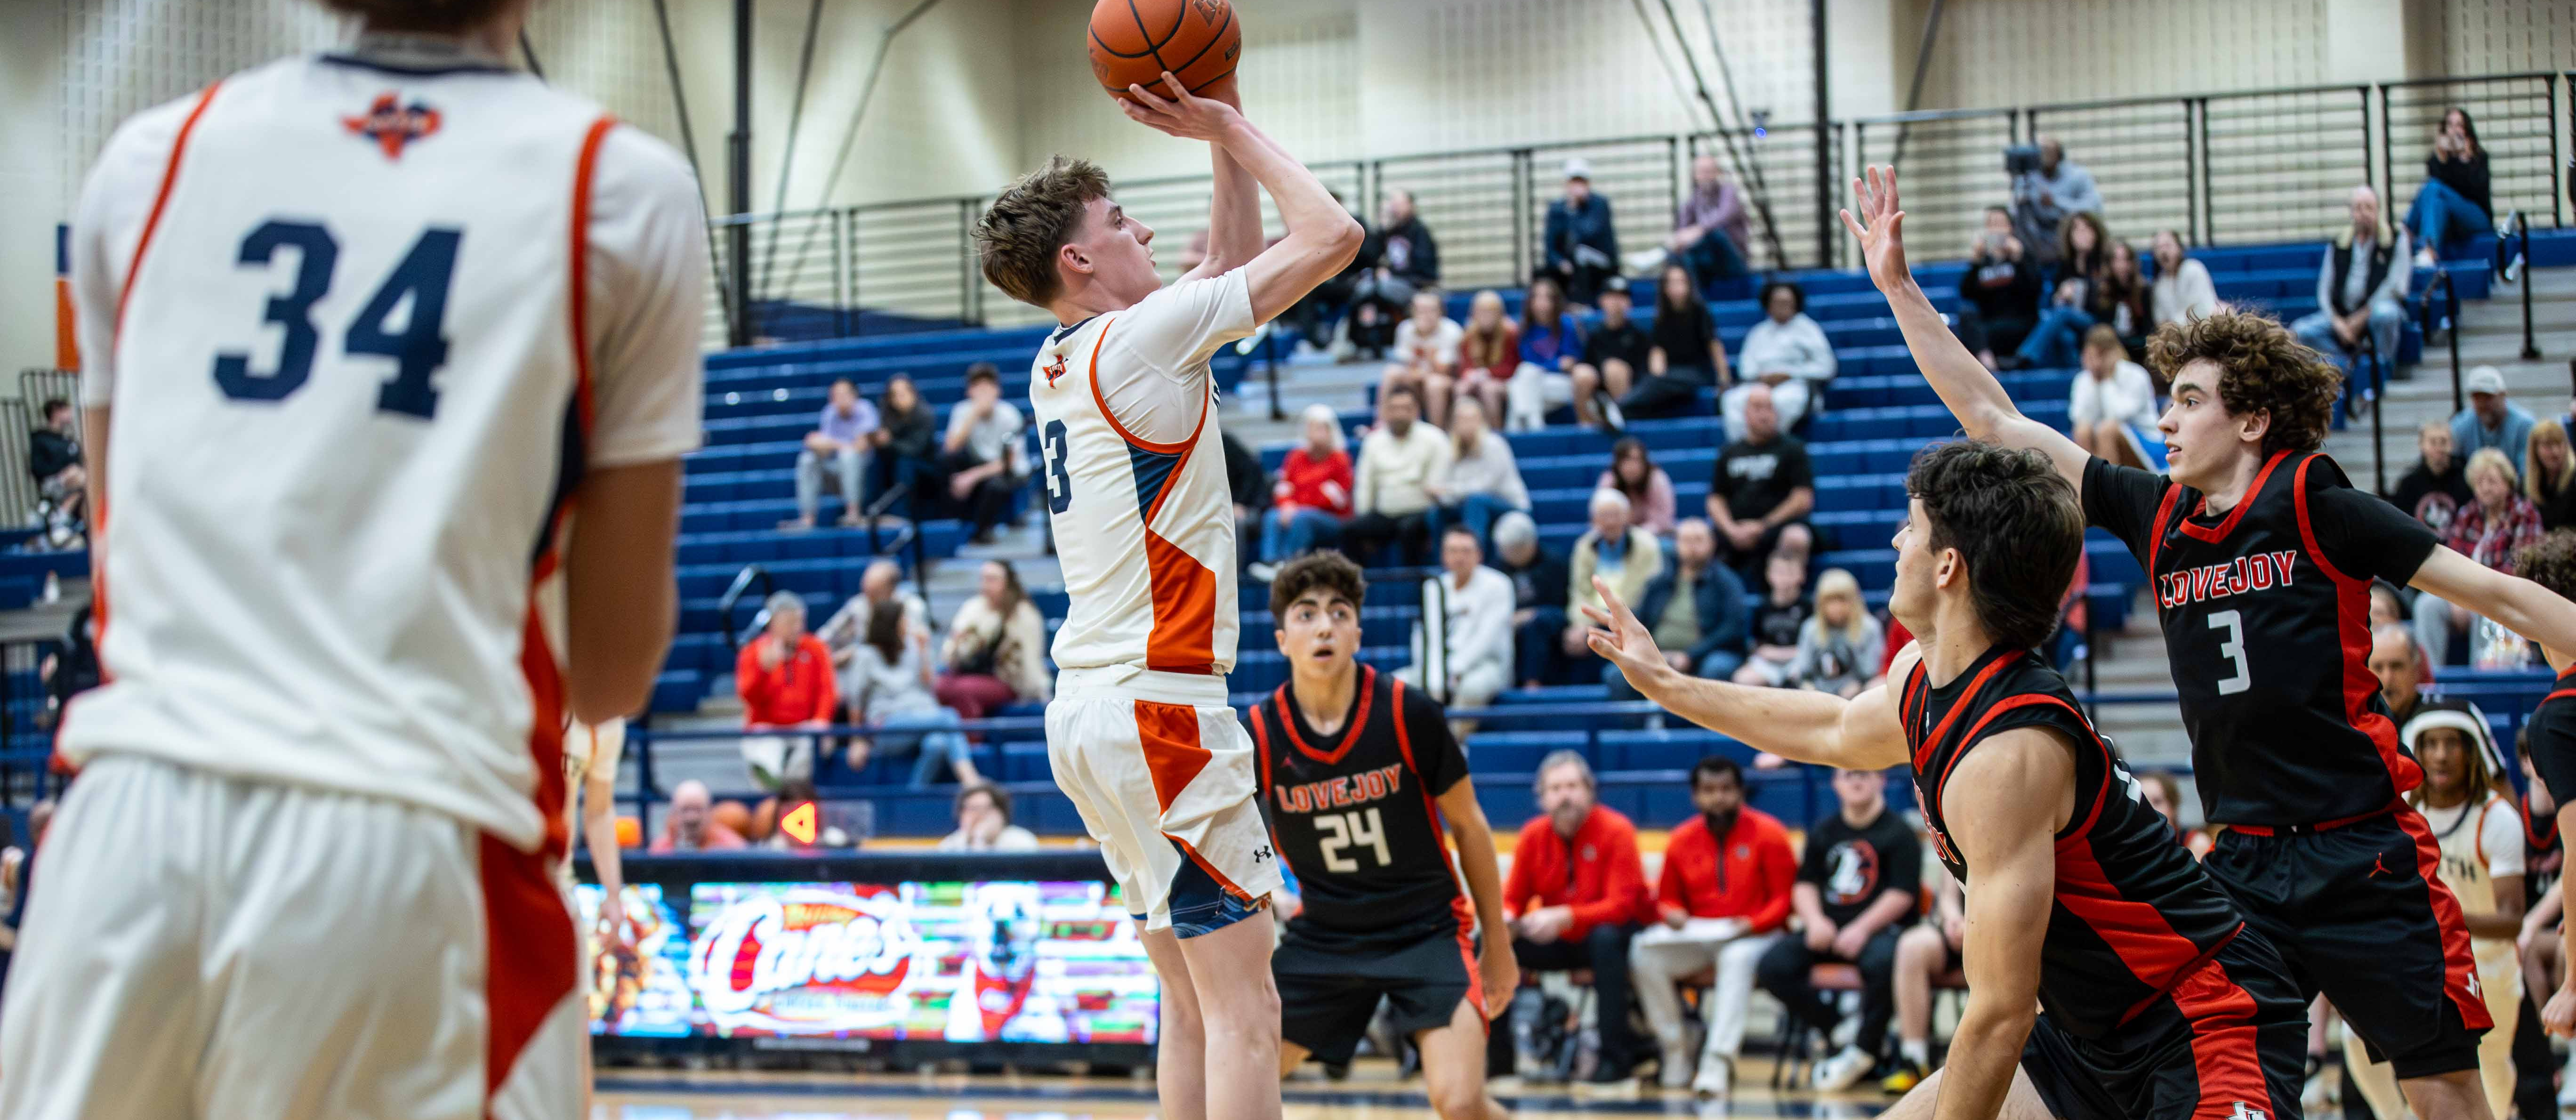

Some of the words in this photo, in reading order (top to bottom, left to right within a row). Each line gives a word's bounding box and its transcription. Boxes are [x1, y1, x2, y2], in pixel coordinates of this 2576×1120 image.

[212, 218, 466, 420] 34
[1044, 418, 1072, 515] 3
[2159, 550, 2297, 609] LOVEJOY
[2208, 609, 2251, 696] 3
[1275, 762, 1402, 813] LOVEJOY
[1313, 807, 1393, 873] 24
